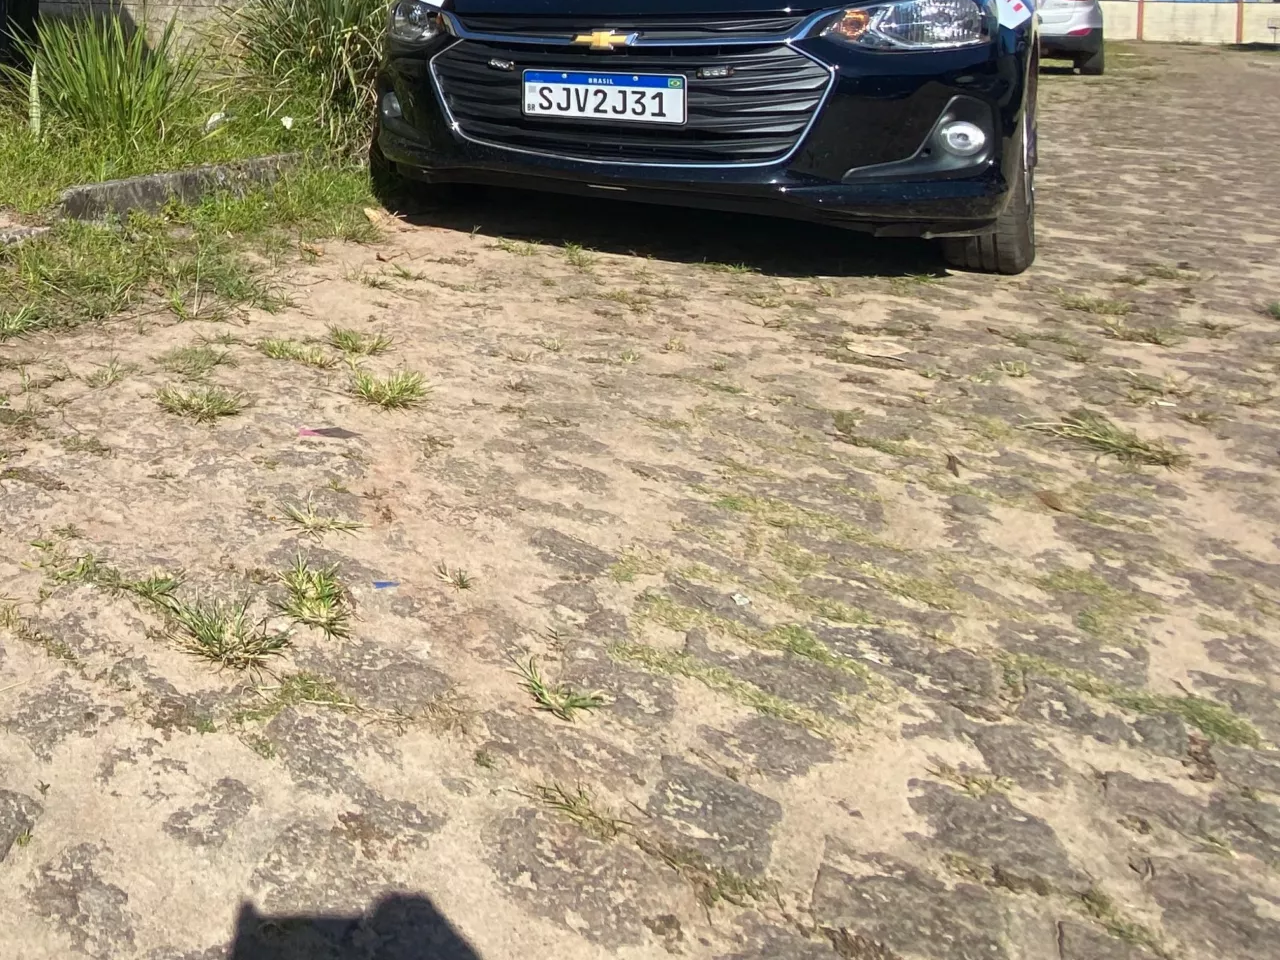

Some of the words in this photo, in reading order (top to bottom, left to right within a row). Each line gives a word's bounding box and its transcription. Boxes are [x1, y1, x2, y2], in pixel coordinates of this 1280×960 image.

[587, 77, 614, 85] BRASIL
[538, 86, 667, 118] SJV2J31
[527, 103, 536, 112] BR
